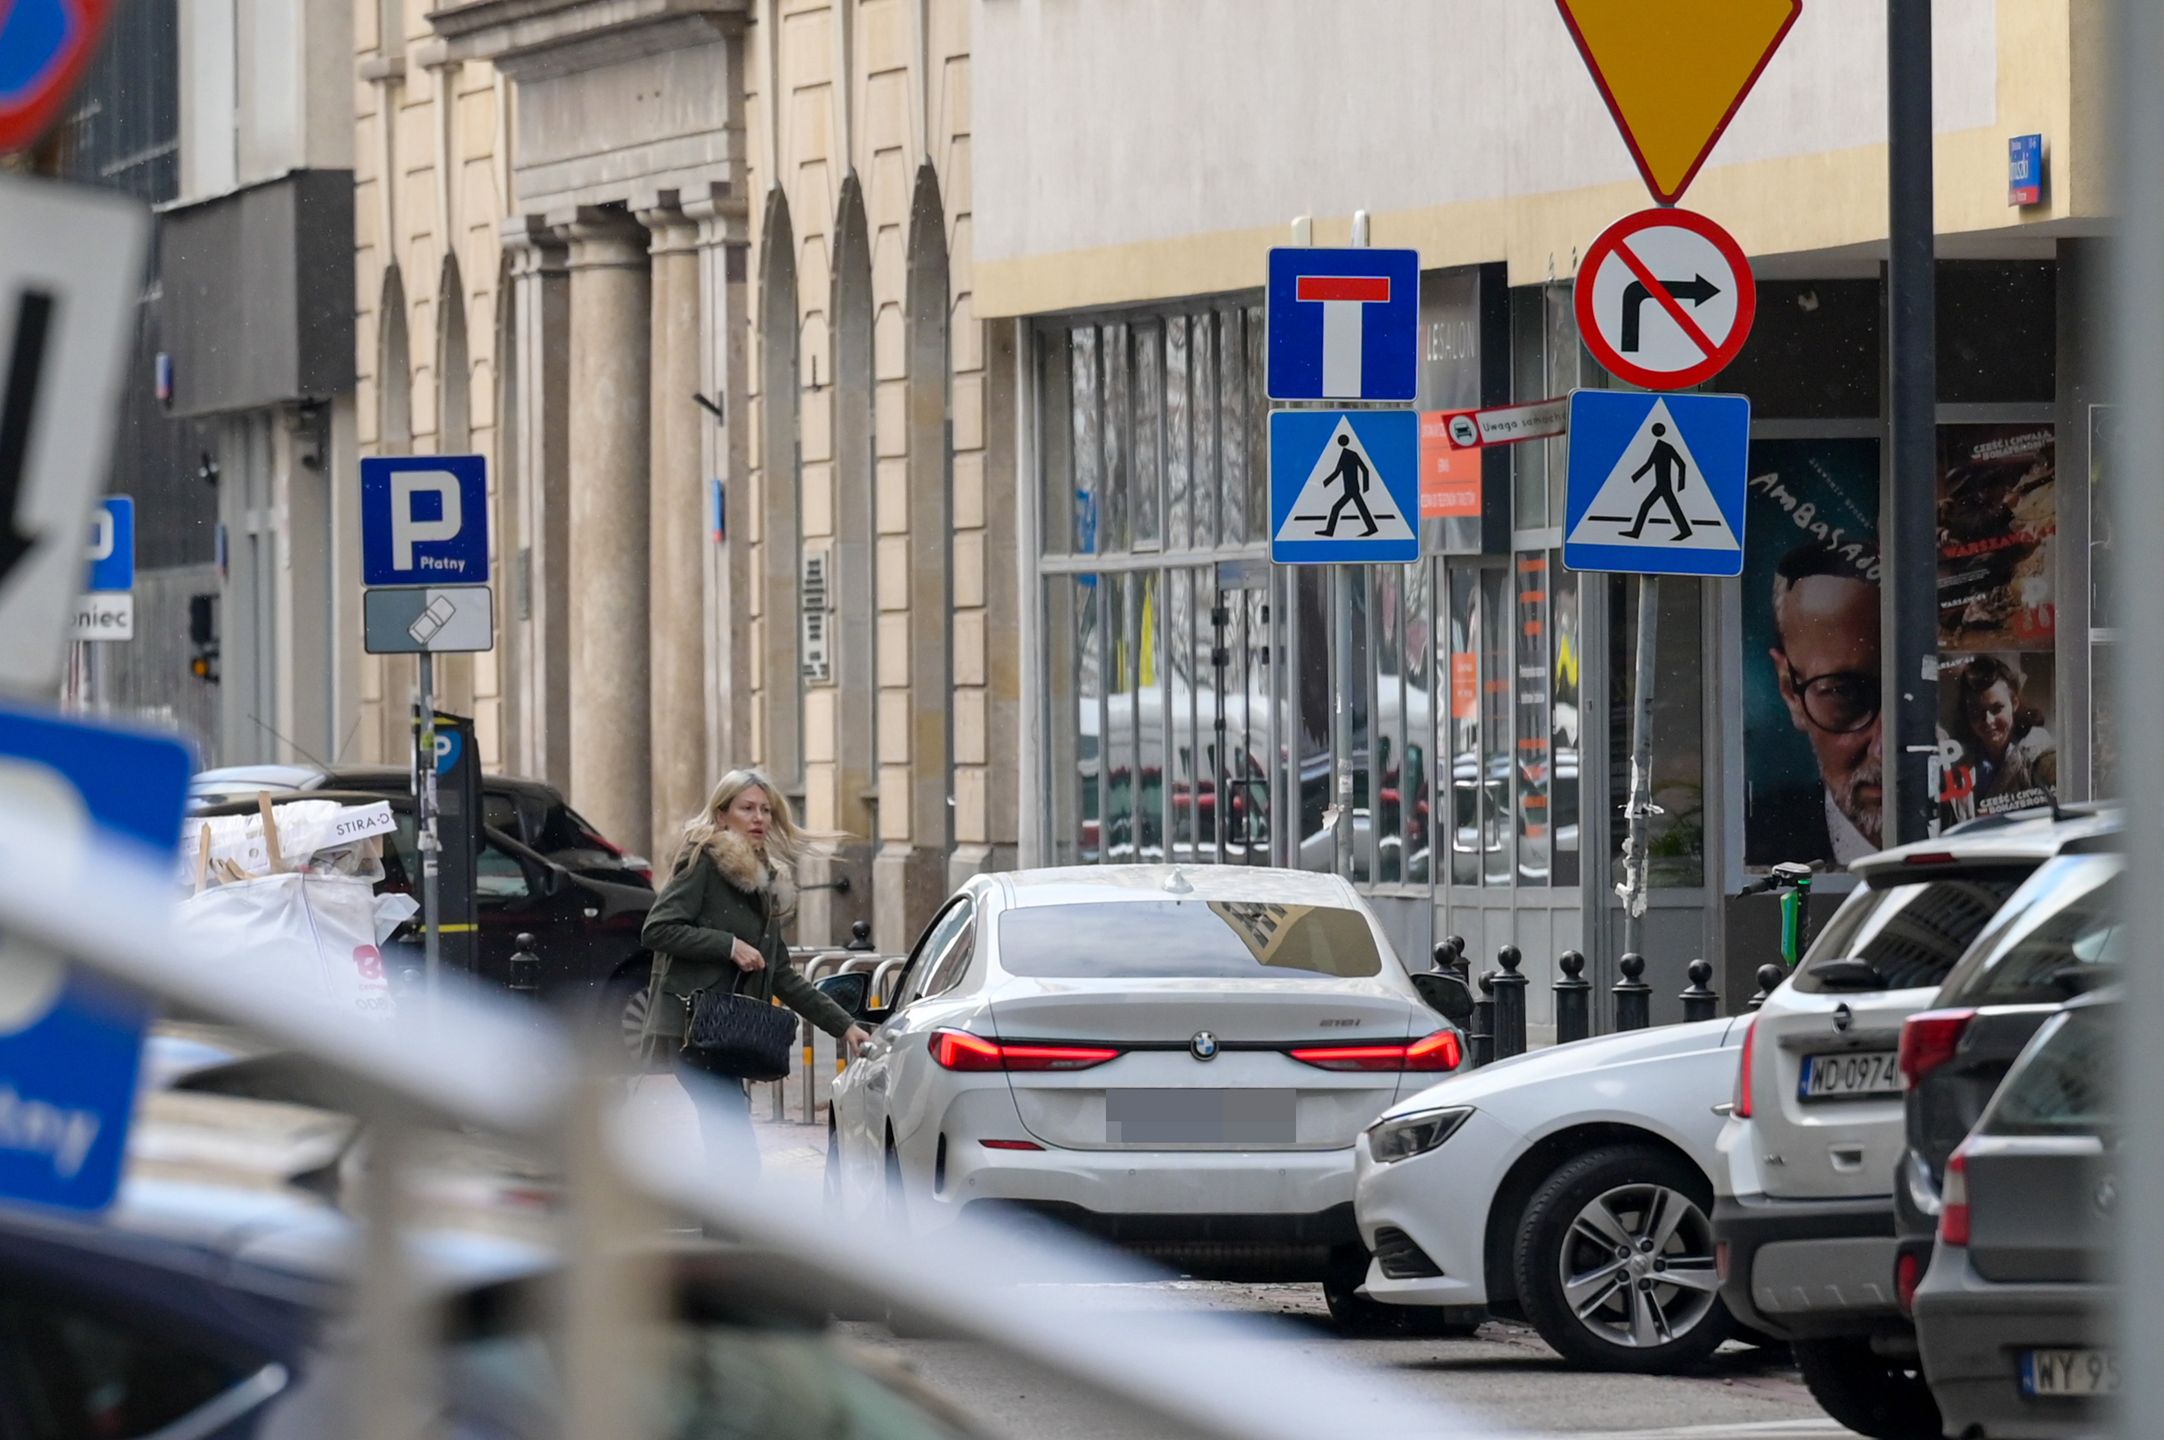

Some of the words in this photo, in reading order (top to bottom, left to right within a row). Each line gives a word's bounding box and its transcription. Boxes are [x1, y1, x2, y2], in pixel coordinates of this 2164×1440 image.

[1483, 420, 1518, 432] Uwaga
[420, 556, 465, 573] Płatny
[1812, 1060, 1838, 1091] WD
[1845, 1056, 1898, 1090] 0974
[2037, 1353, 2074, 1390] WY
